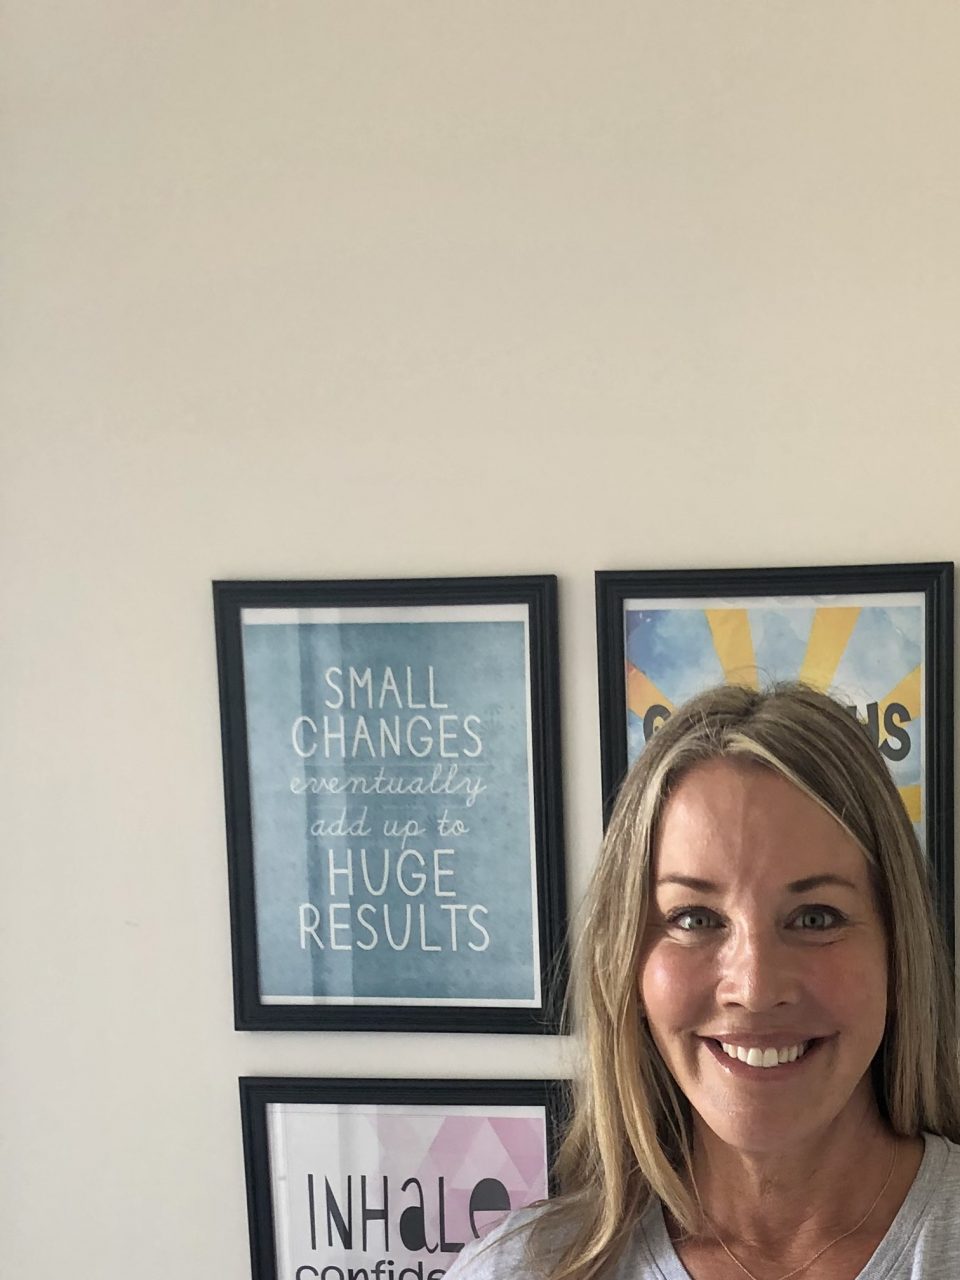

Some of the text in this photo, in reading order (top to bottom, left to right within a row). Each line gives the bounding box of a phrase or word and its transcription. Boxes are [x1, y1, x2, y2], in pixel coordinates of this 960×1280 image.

[325, 665, 449, 710] SMALL
[291, 714, 484, 759] CHANGES
[289, 763, 488, 807] eventually
[310, 806, 470, 850] add up to
[327, 848, 457, 898] HUGE
[298, 902, 491, 953] RESULTS
